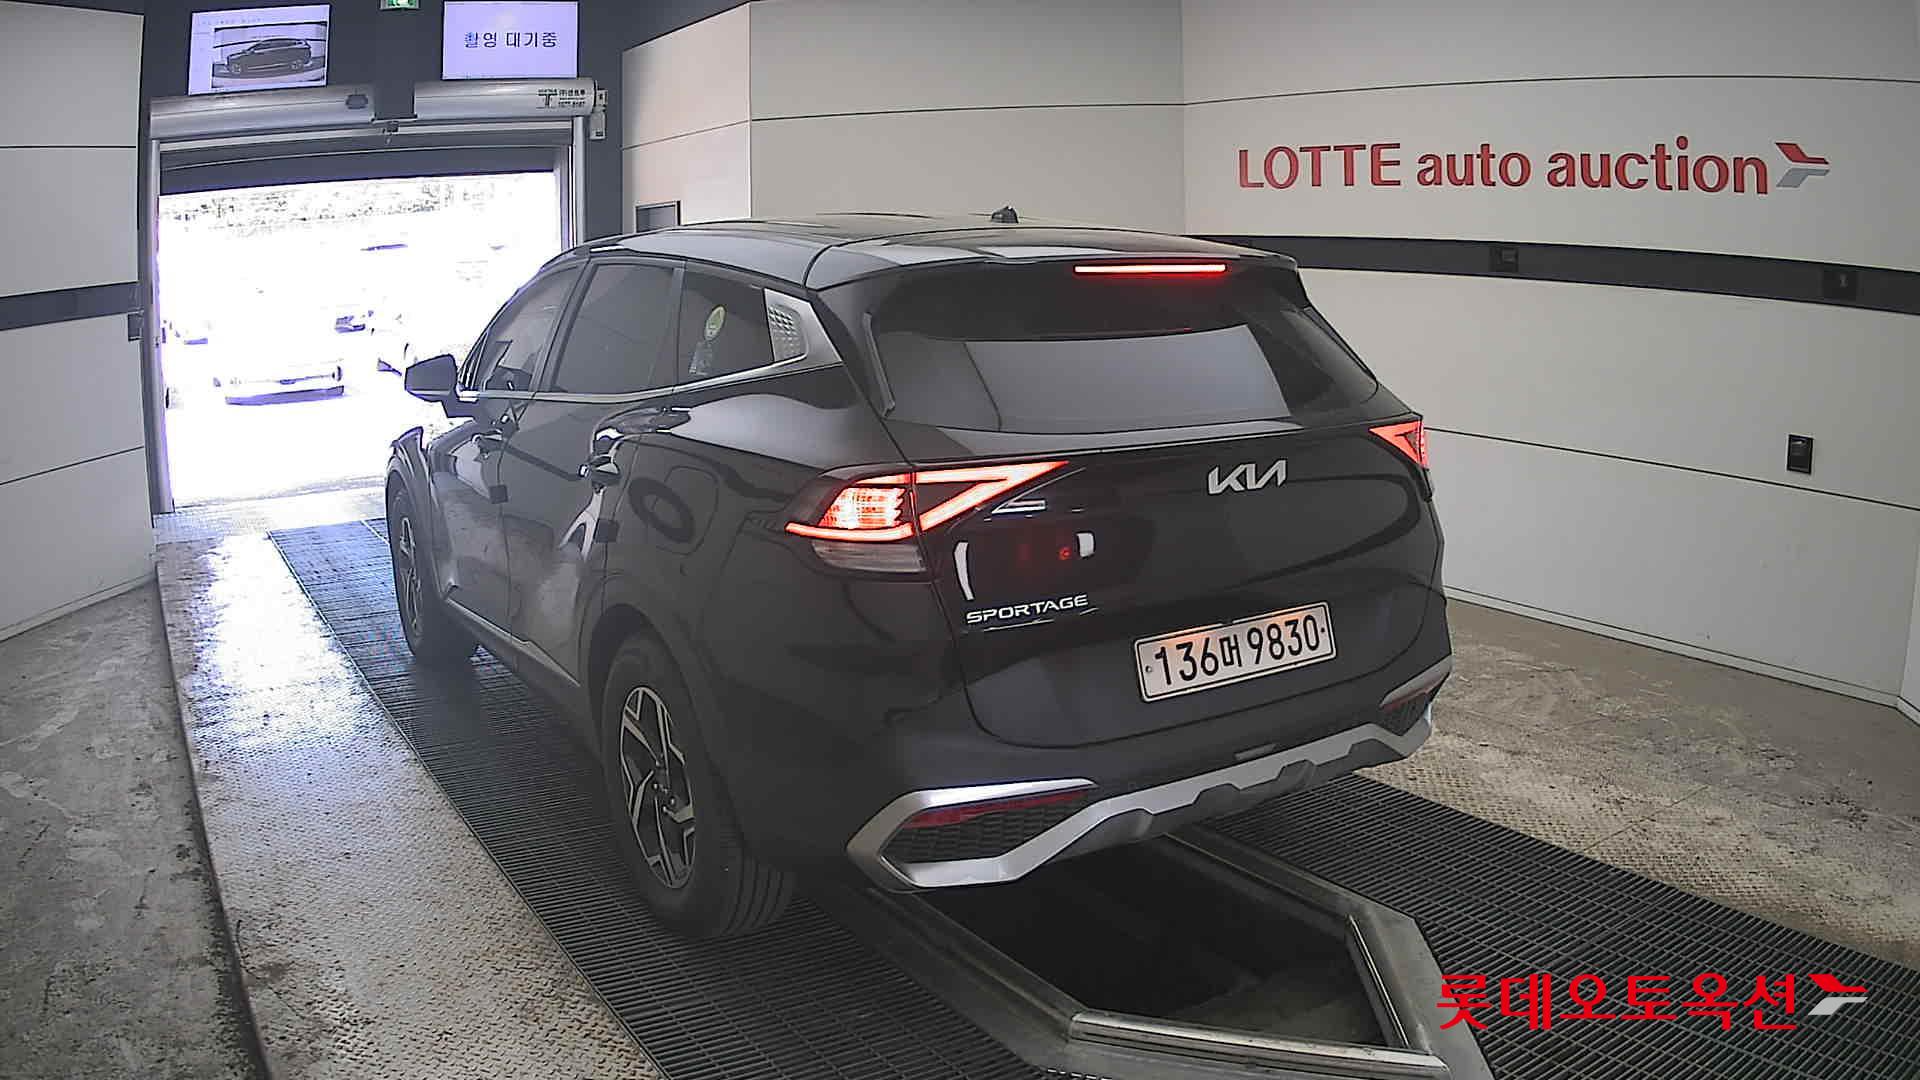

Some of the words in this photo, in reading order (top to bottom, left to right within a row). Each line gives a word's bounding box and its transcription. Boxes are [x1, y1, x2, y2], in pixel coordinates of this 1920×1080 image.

[506, 31, 558, 48] 대기중
[1238, 143, 1401, 189] LOTTE
[1416, 143, 1531, 187] auto
[1547, 134, 1768, 195] auction
[966, 594, 1089, 624] SPORTAGE
